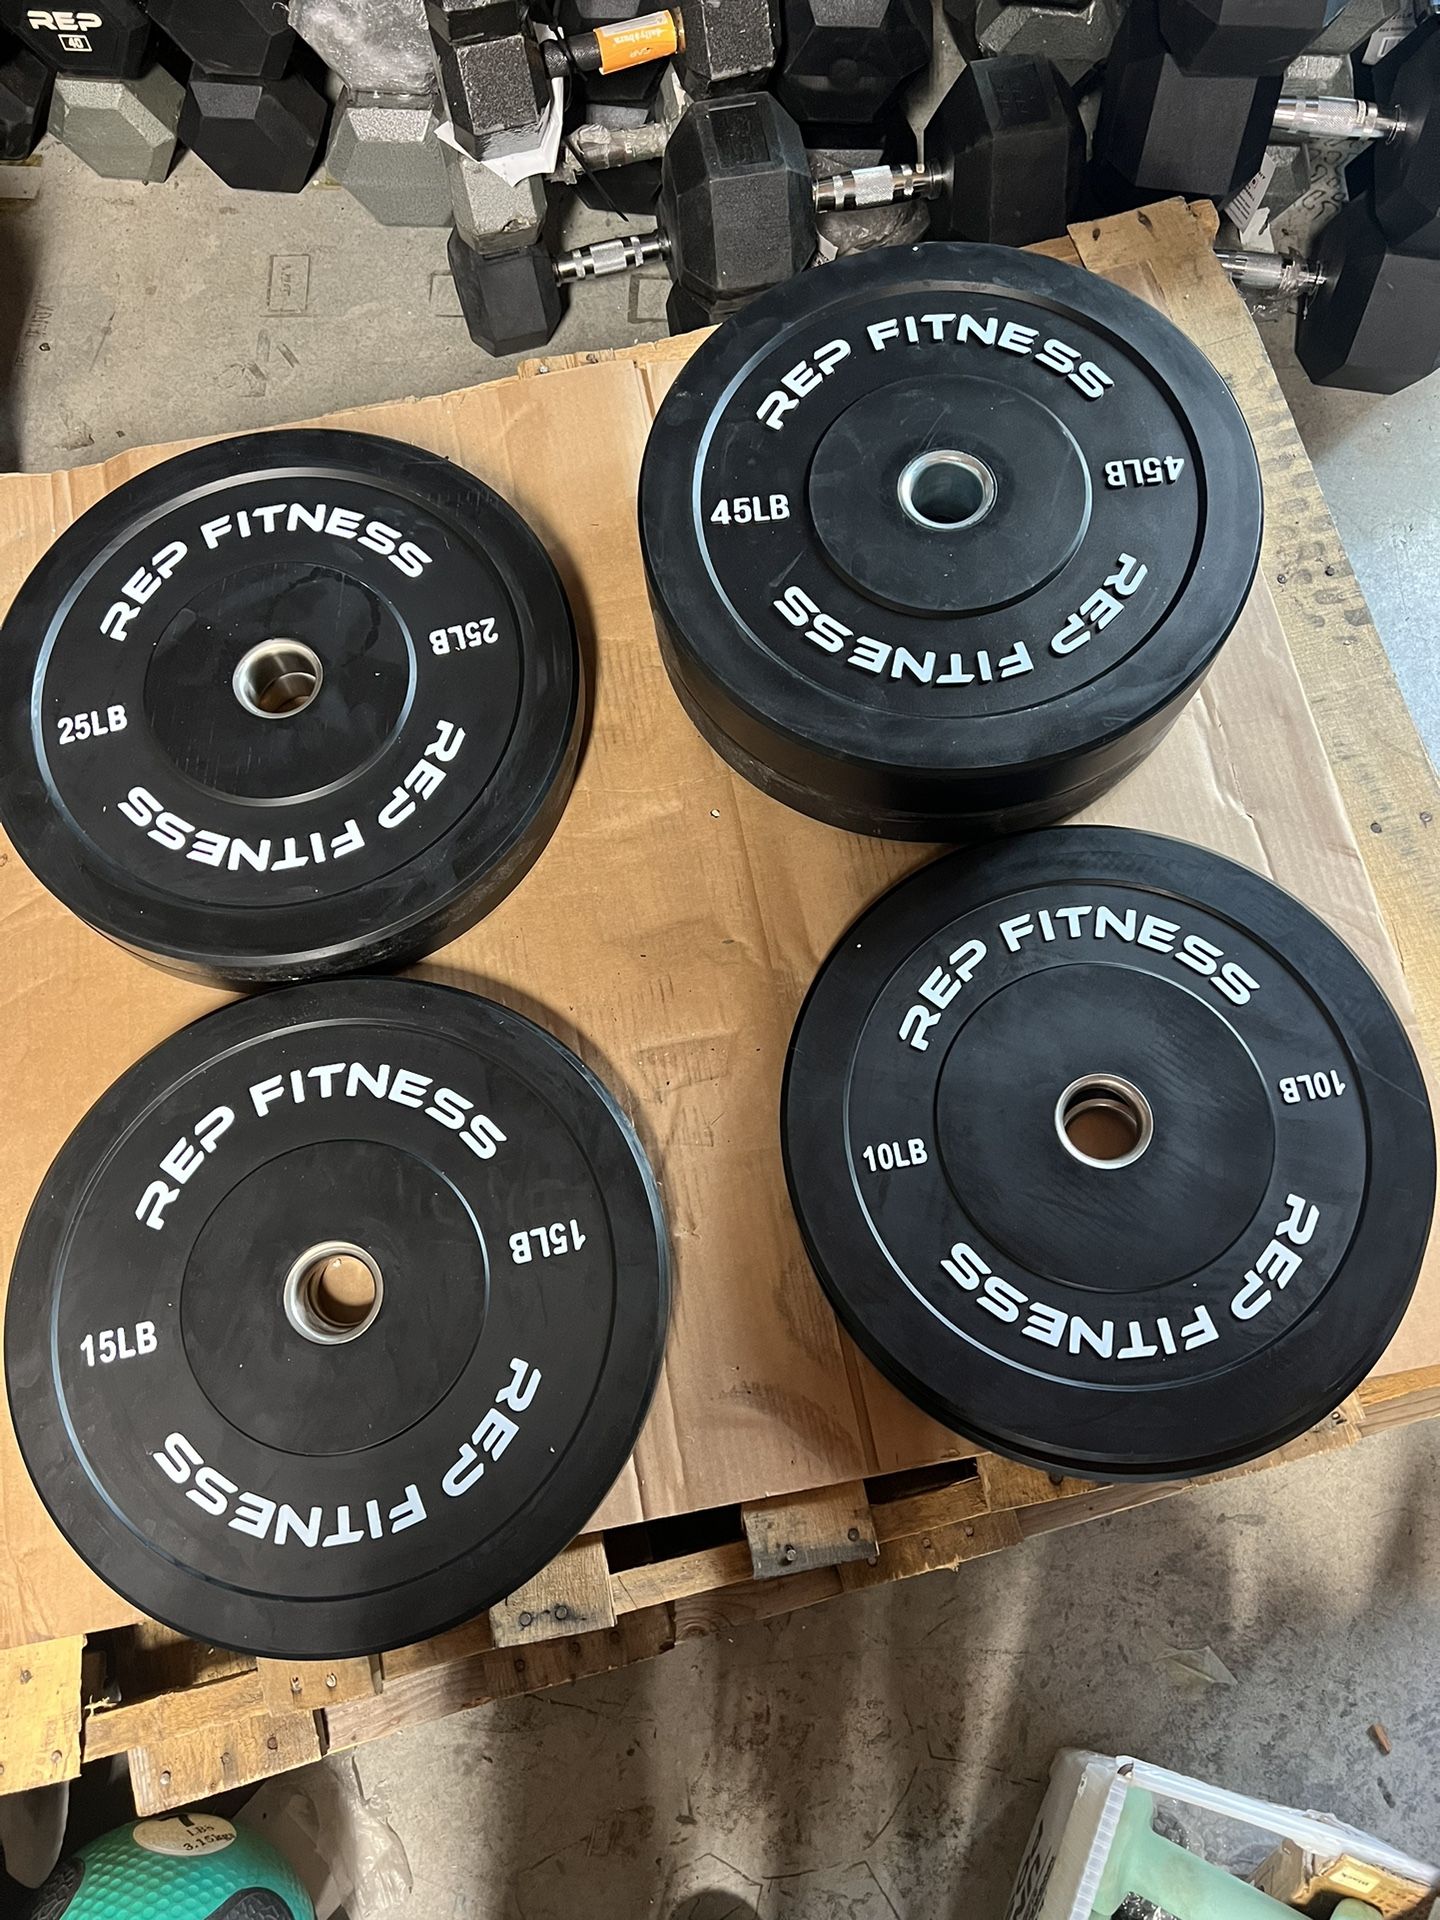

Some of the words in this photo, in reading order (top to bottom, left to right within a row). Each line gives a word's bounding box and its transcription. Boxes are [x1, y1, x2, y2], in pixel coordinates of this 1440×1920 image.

[27, 10, 103, 32] REP
[68, 37, 84, 49] 40
[755, 339, 852, 431] REP
[866, 313, 1115, 398] FITNESS
[709, 494, 791, 526] 45LB
[1104, 455, 1185, 488] 45LB
[99, 541, 188, 642] REP
[200, 502, 433, 578] FITNESS
[1051, 552, 1149, 654] REP
[428, 617, 499, 656] 25LB
[773, 585, 1035, 684] FITNESS
[57, 704, 128, 745] 25LB
[377, 719, 466, 829] REP
[117, 786, 366, 872] FITNESS
[898, 939, 987, 1051] REP
[999, 905, 1261, 1005] FITNESS
[1279, 1069, 1346, 1104] 10LB
[134, 1105, 236, 1231] REP
[248, 1061, 508, 1160] FITNESS
[862, 1138, 928, 1172] 10LB
[508, 1218, 586, 1264] 15LB
[1230, 1193, 1320, 1320] REP
[79, 1320, 158, 1368] 15LB
[940, 1242, 1220, 1360] FITNESS
[441, 1357, 542, 1497] REP
[152, 1432, 428, 1548] FITNESS
